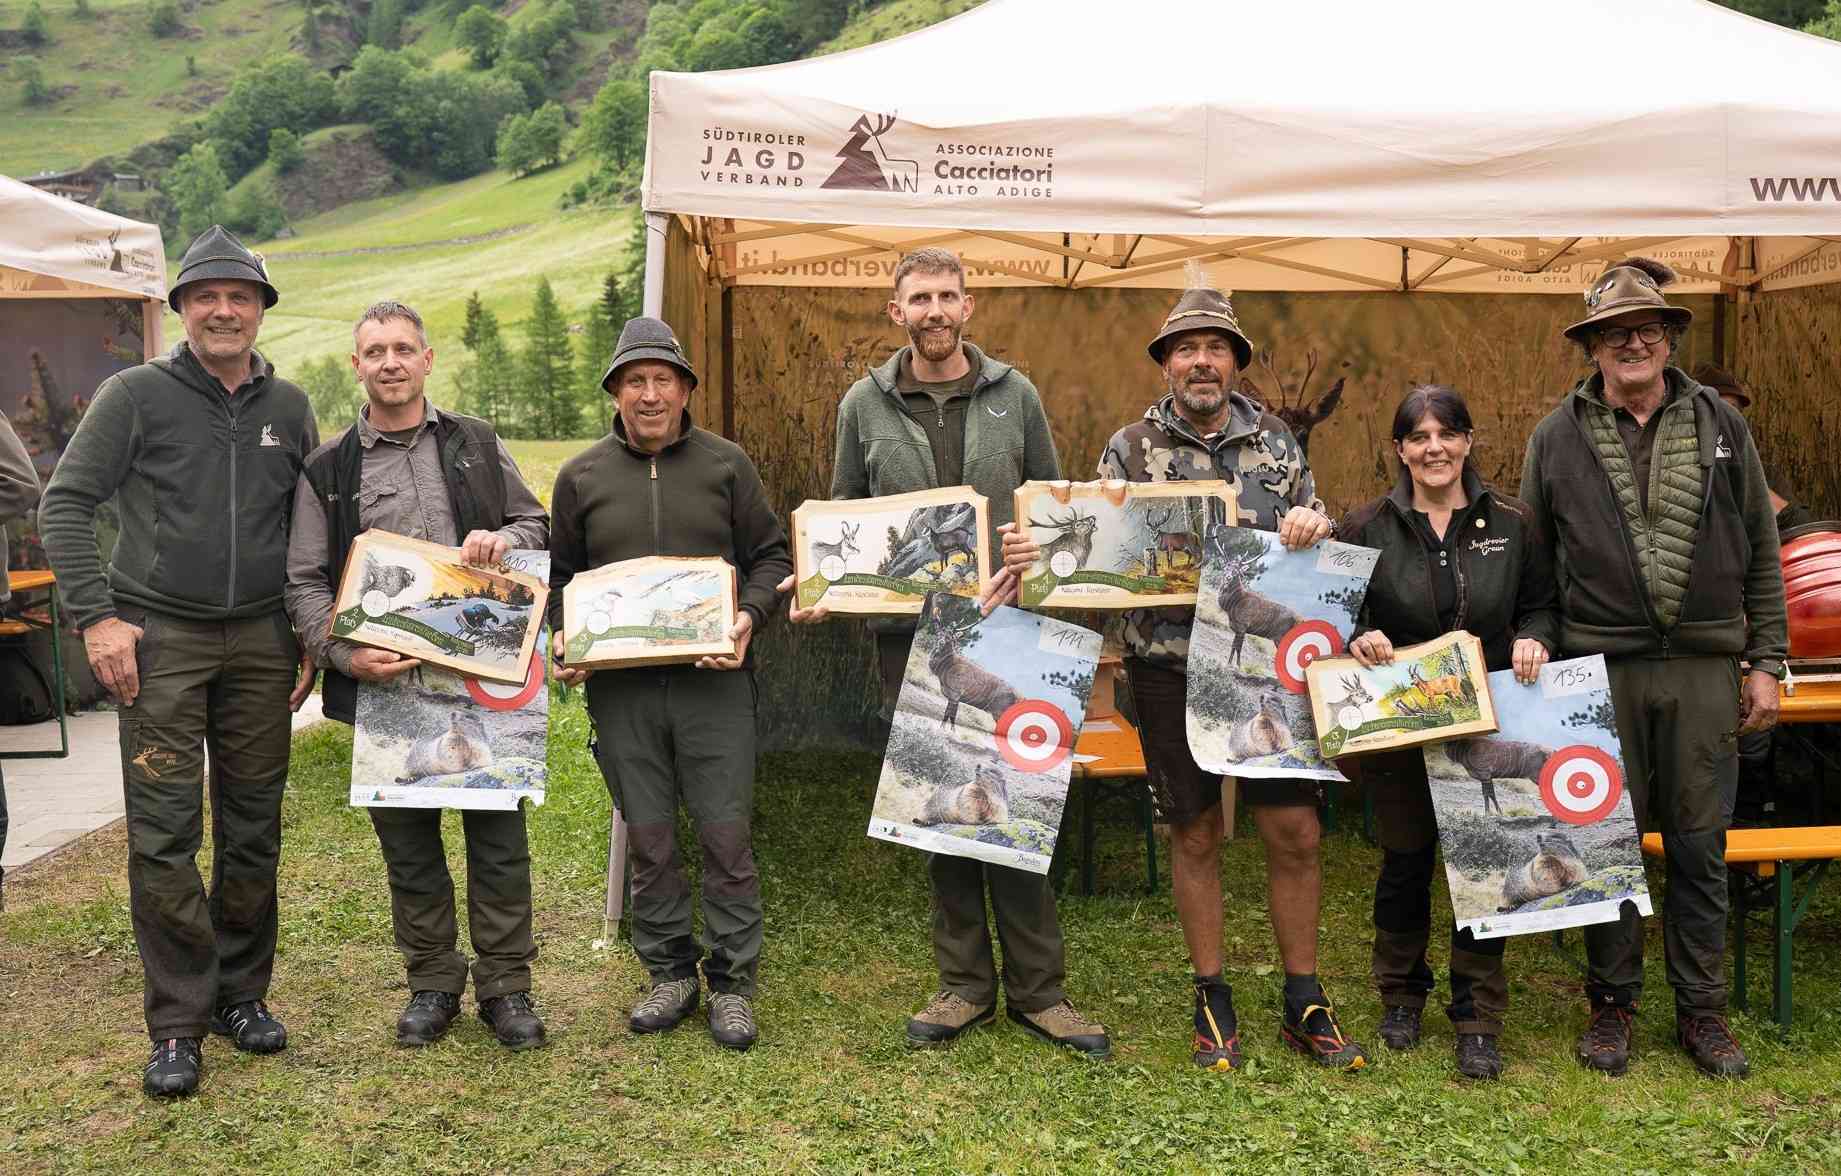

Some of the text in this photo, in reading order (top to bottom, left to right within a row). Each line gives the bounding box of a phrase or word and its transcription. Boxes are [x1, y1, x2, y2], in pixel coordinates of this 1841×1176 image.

[703, 127, 805, 146] SÜDTIROLER
[701, 146, 805, 170] JAGD
[935, 143, 1054, 158] ASSOCIAZIONE
[700, 170, 804, 186] VERBAND
[934, 160, 1053, 182] Cacciatori
[933, 184, 1053, 198] ALTO ADIGE
